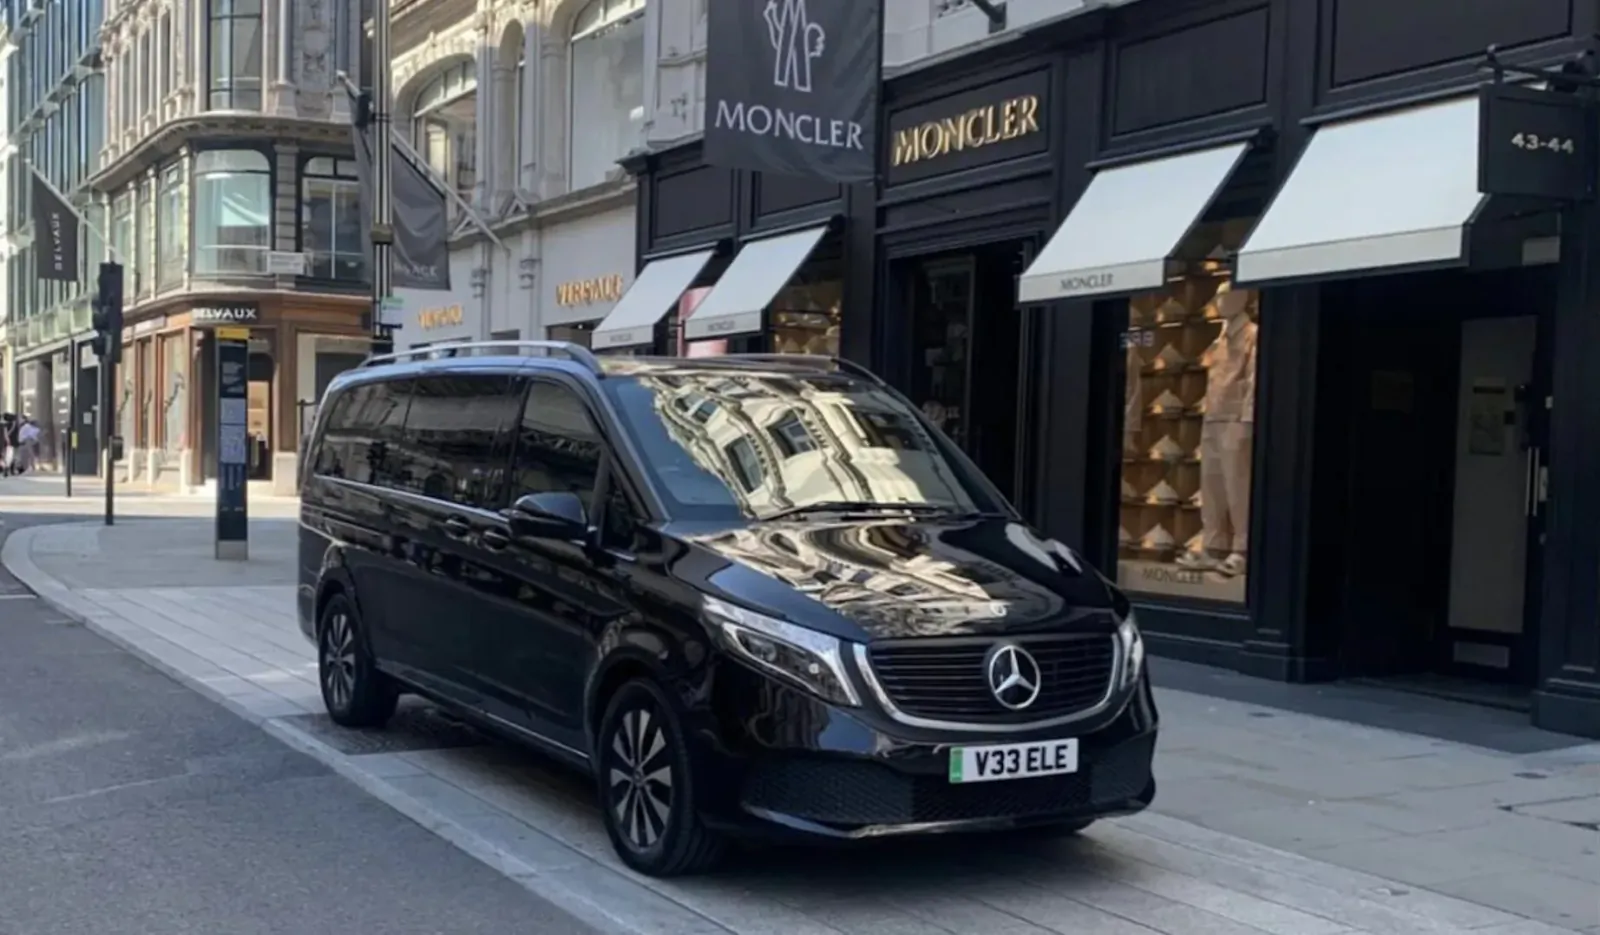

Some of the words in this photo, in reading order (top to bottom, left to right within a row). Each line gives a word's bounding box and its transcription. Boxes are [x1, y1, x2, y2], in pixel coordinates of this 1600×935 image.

[715, 100, 863, 150] MONCLER
[893, 95, 1038, 166] MONCLER
[1511, 133, 1574, 154] 43-44
[1061, 273, 1113, 290] MONCLER
[975, 749, 1021, 777] V33
[1027, 744, 1069, 772] ELE
